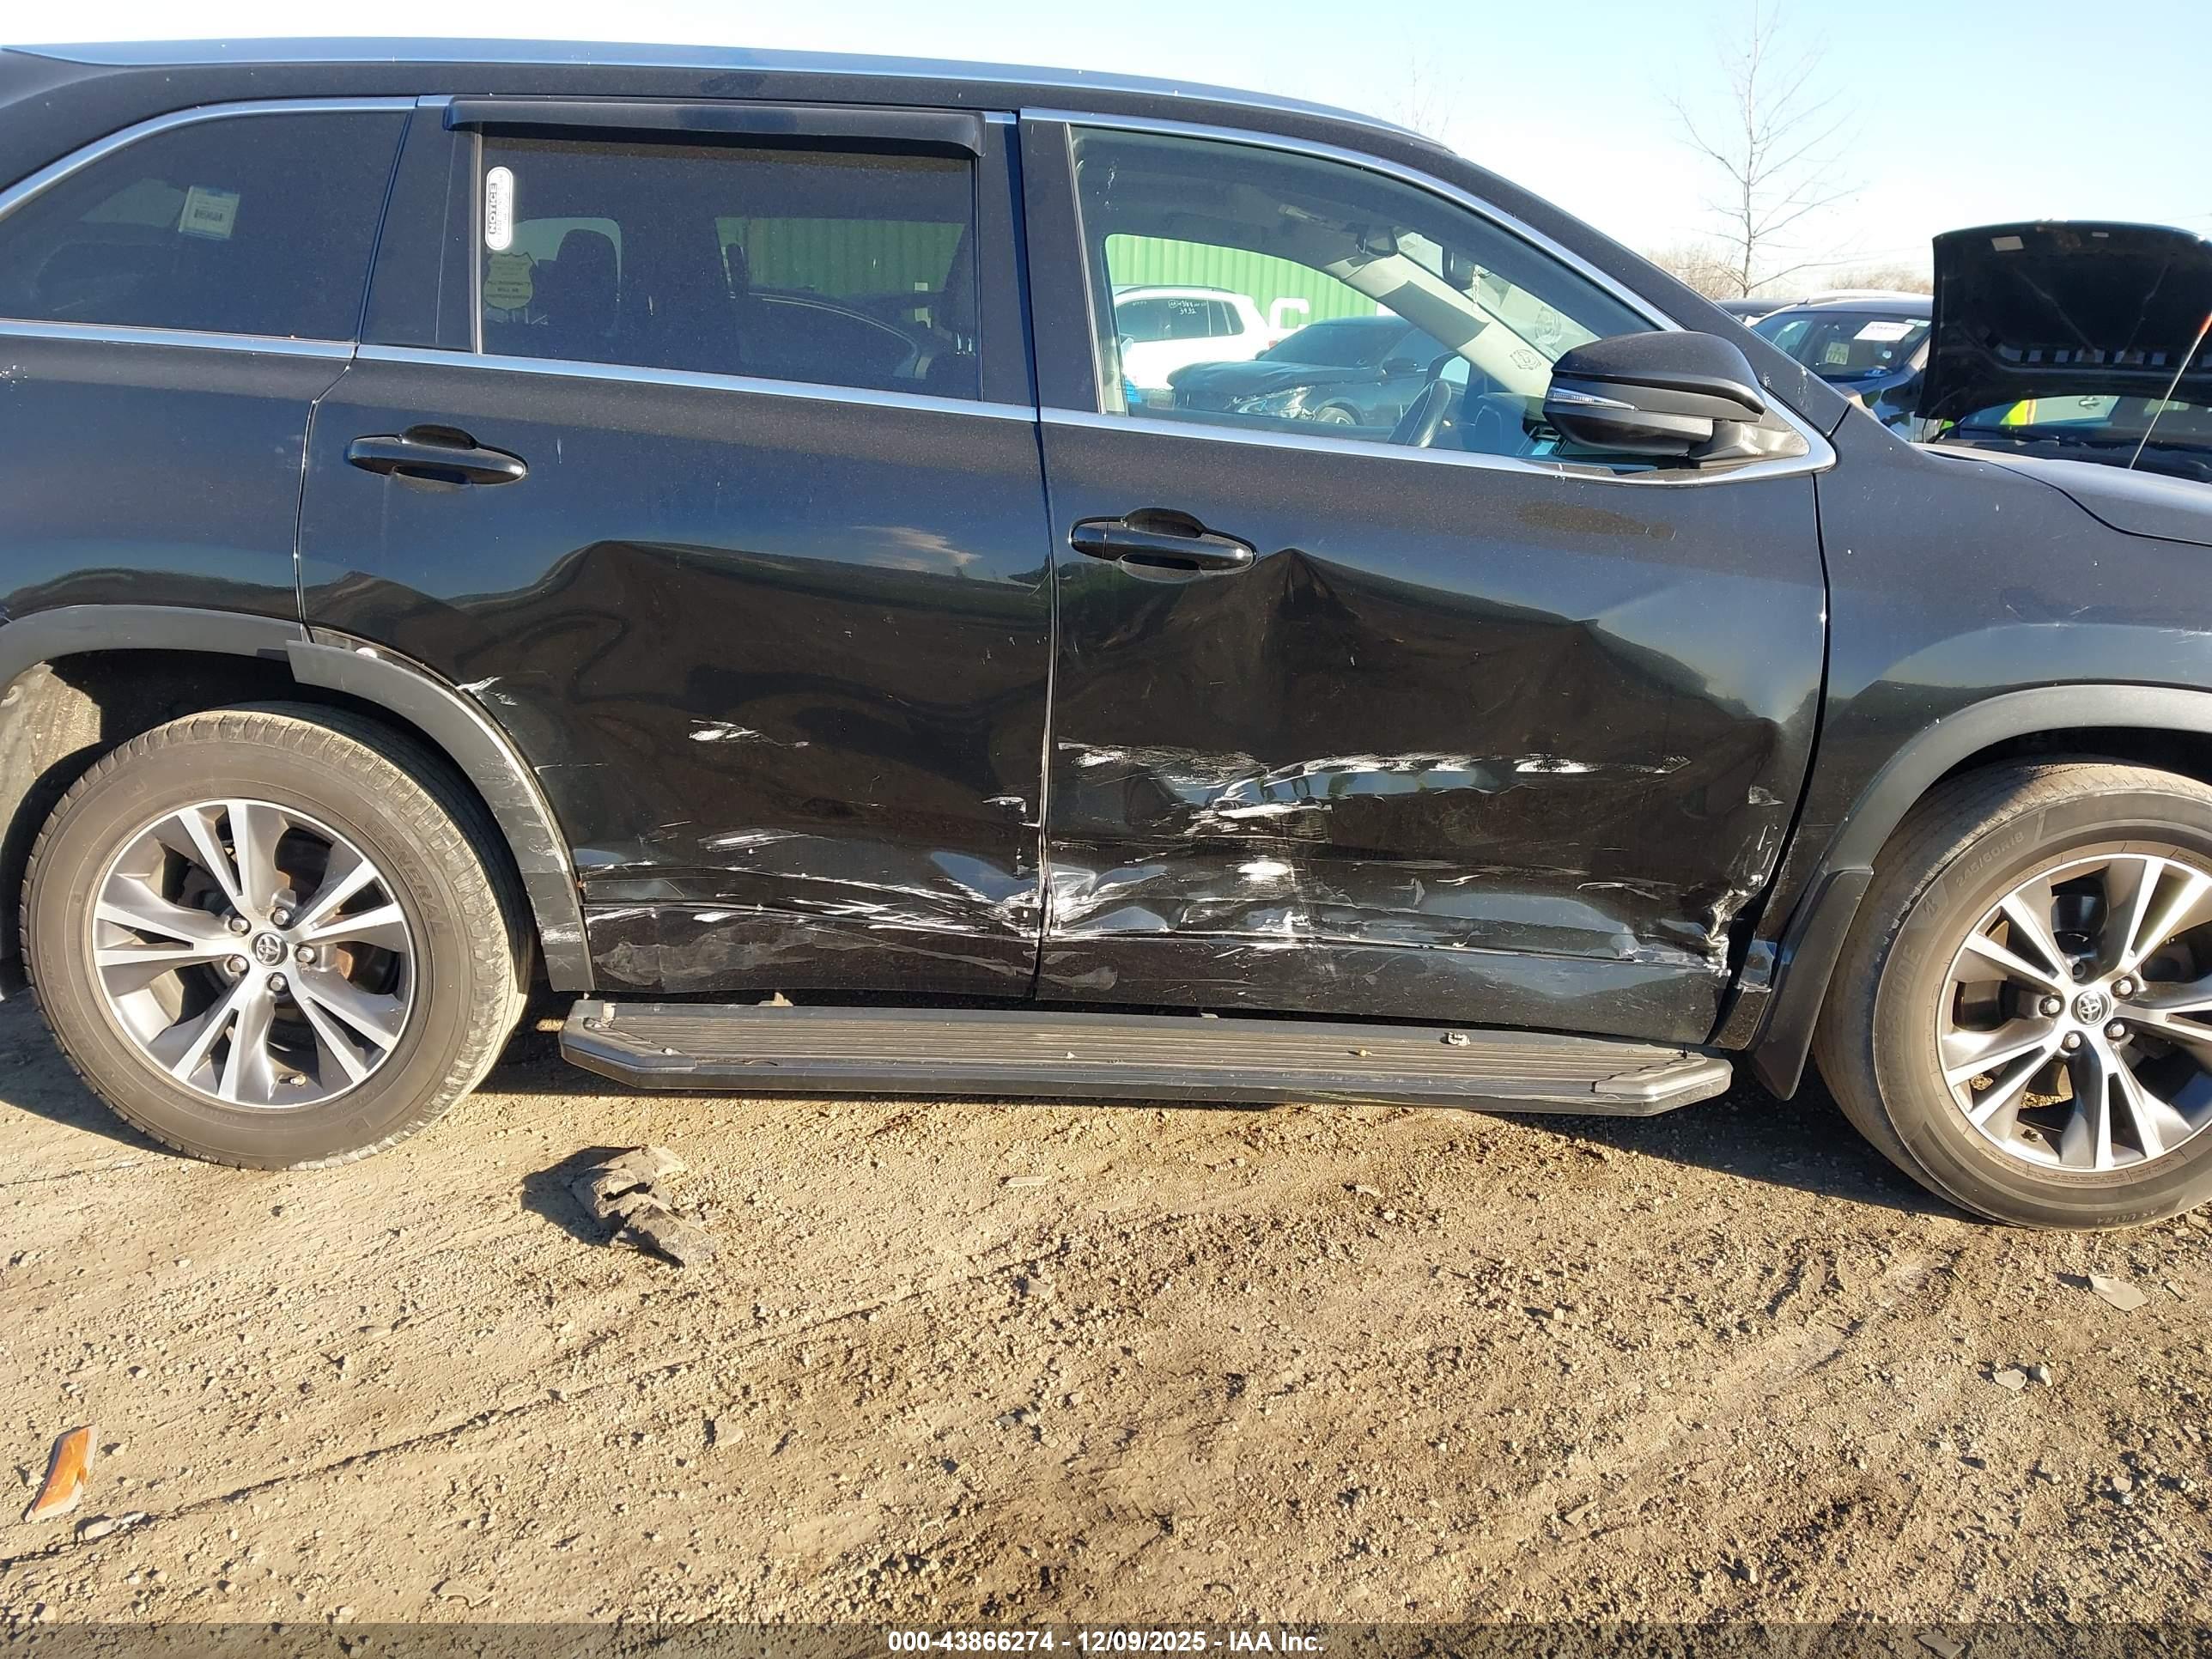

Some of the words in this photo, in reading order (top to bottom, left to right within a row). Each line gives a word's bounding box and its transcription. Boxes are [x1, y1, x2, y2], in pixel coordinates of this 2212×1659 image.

[488, 182, 497, 234] NOTICE
[364, 822, 446, 937] GENERAL
[1954, 829, 2025, 887] 245/60R18
[2097, 1212, 2137, 1225] ULTRA
